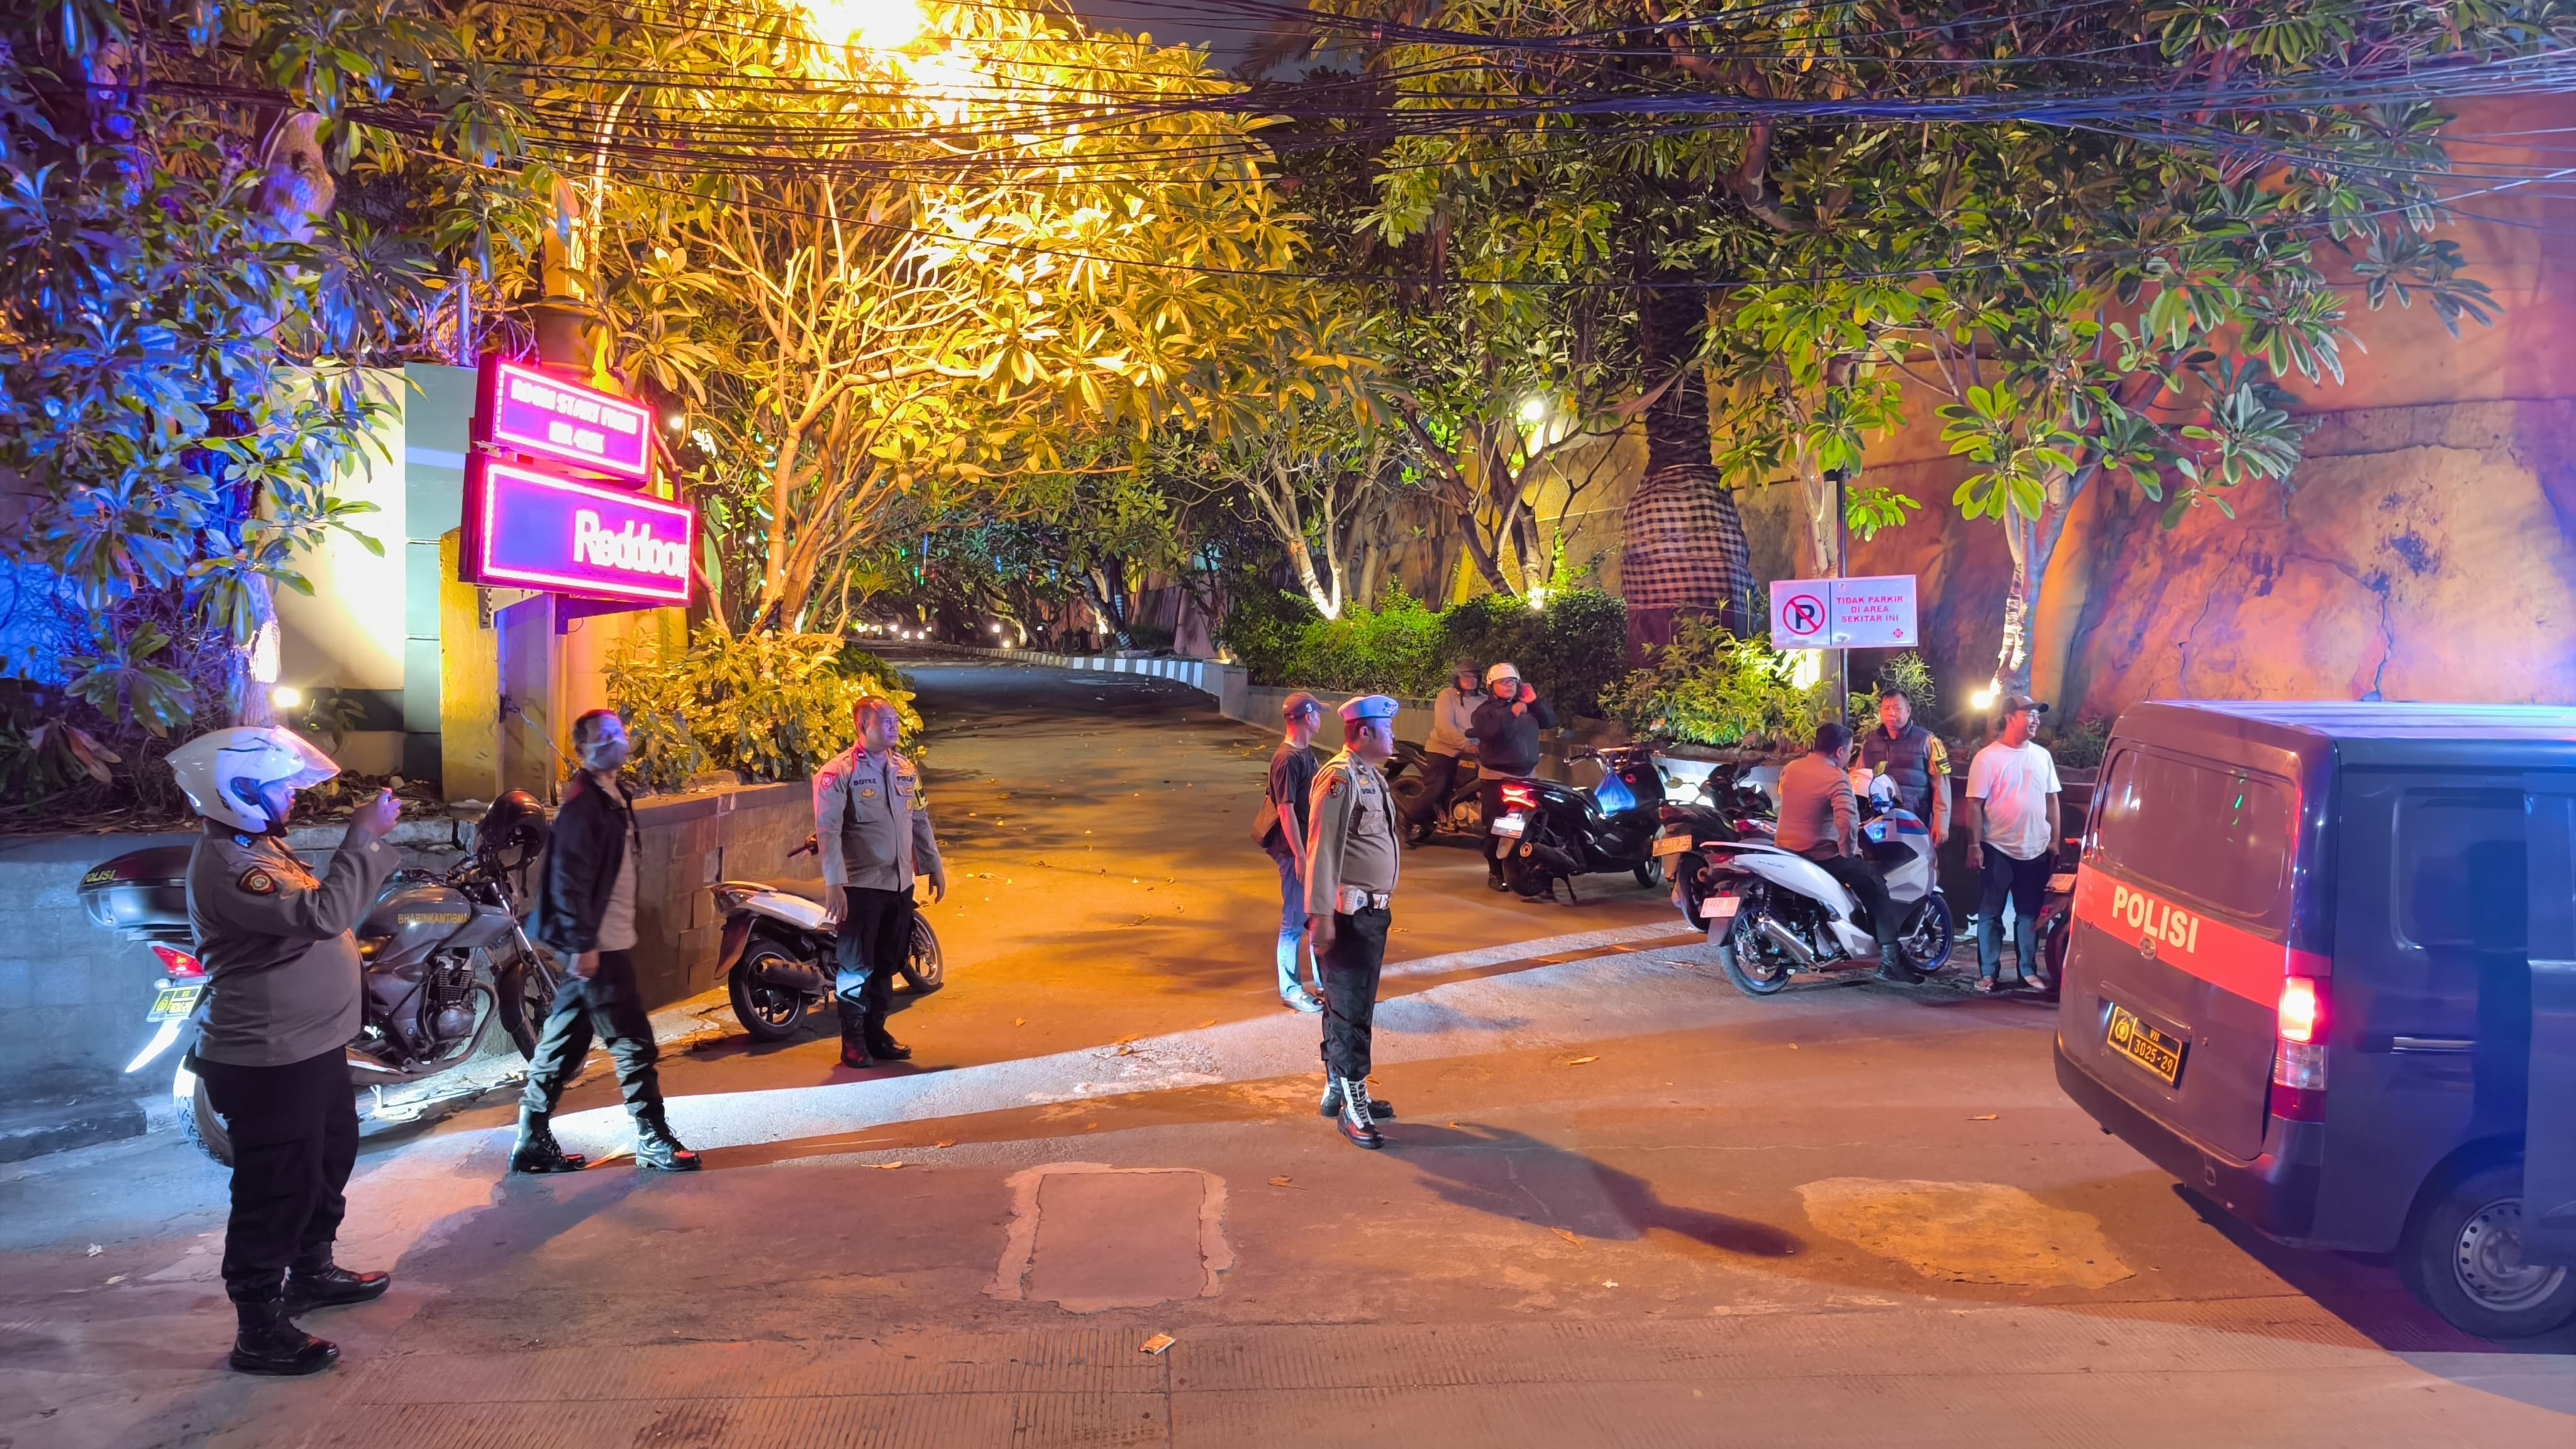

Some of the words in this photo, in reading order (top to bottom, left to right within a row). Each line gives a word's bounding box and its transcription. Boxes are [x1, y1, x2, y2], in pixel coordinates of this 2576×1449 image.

[557, 393, 601, 423] START
[2112, 885, 2199, 953] POLISI
[2135, 1039, 2174, 1072] 3025-29
